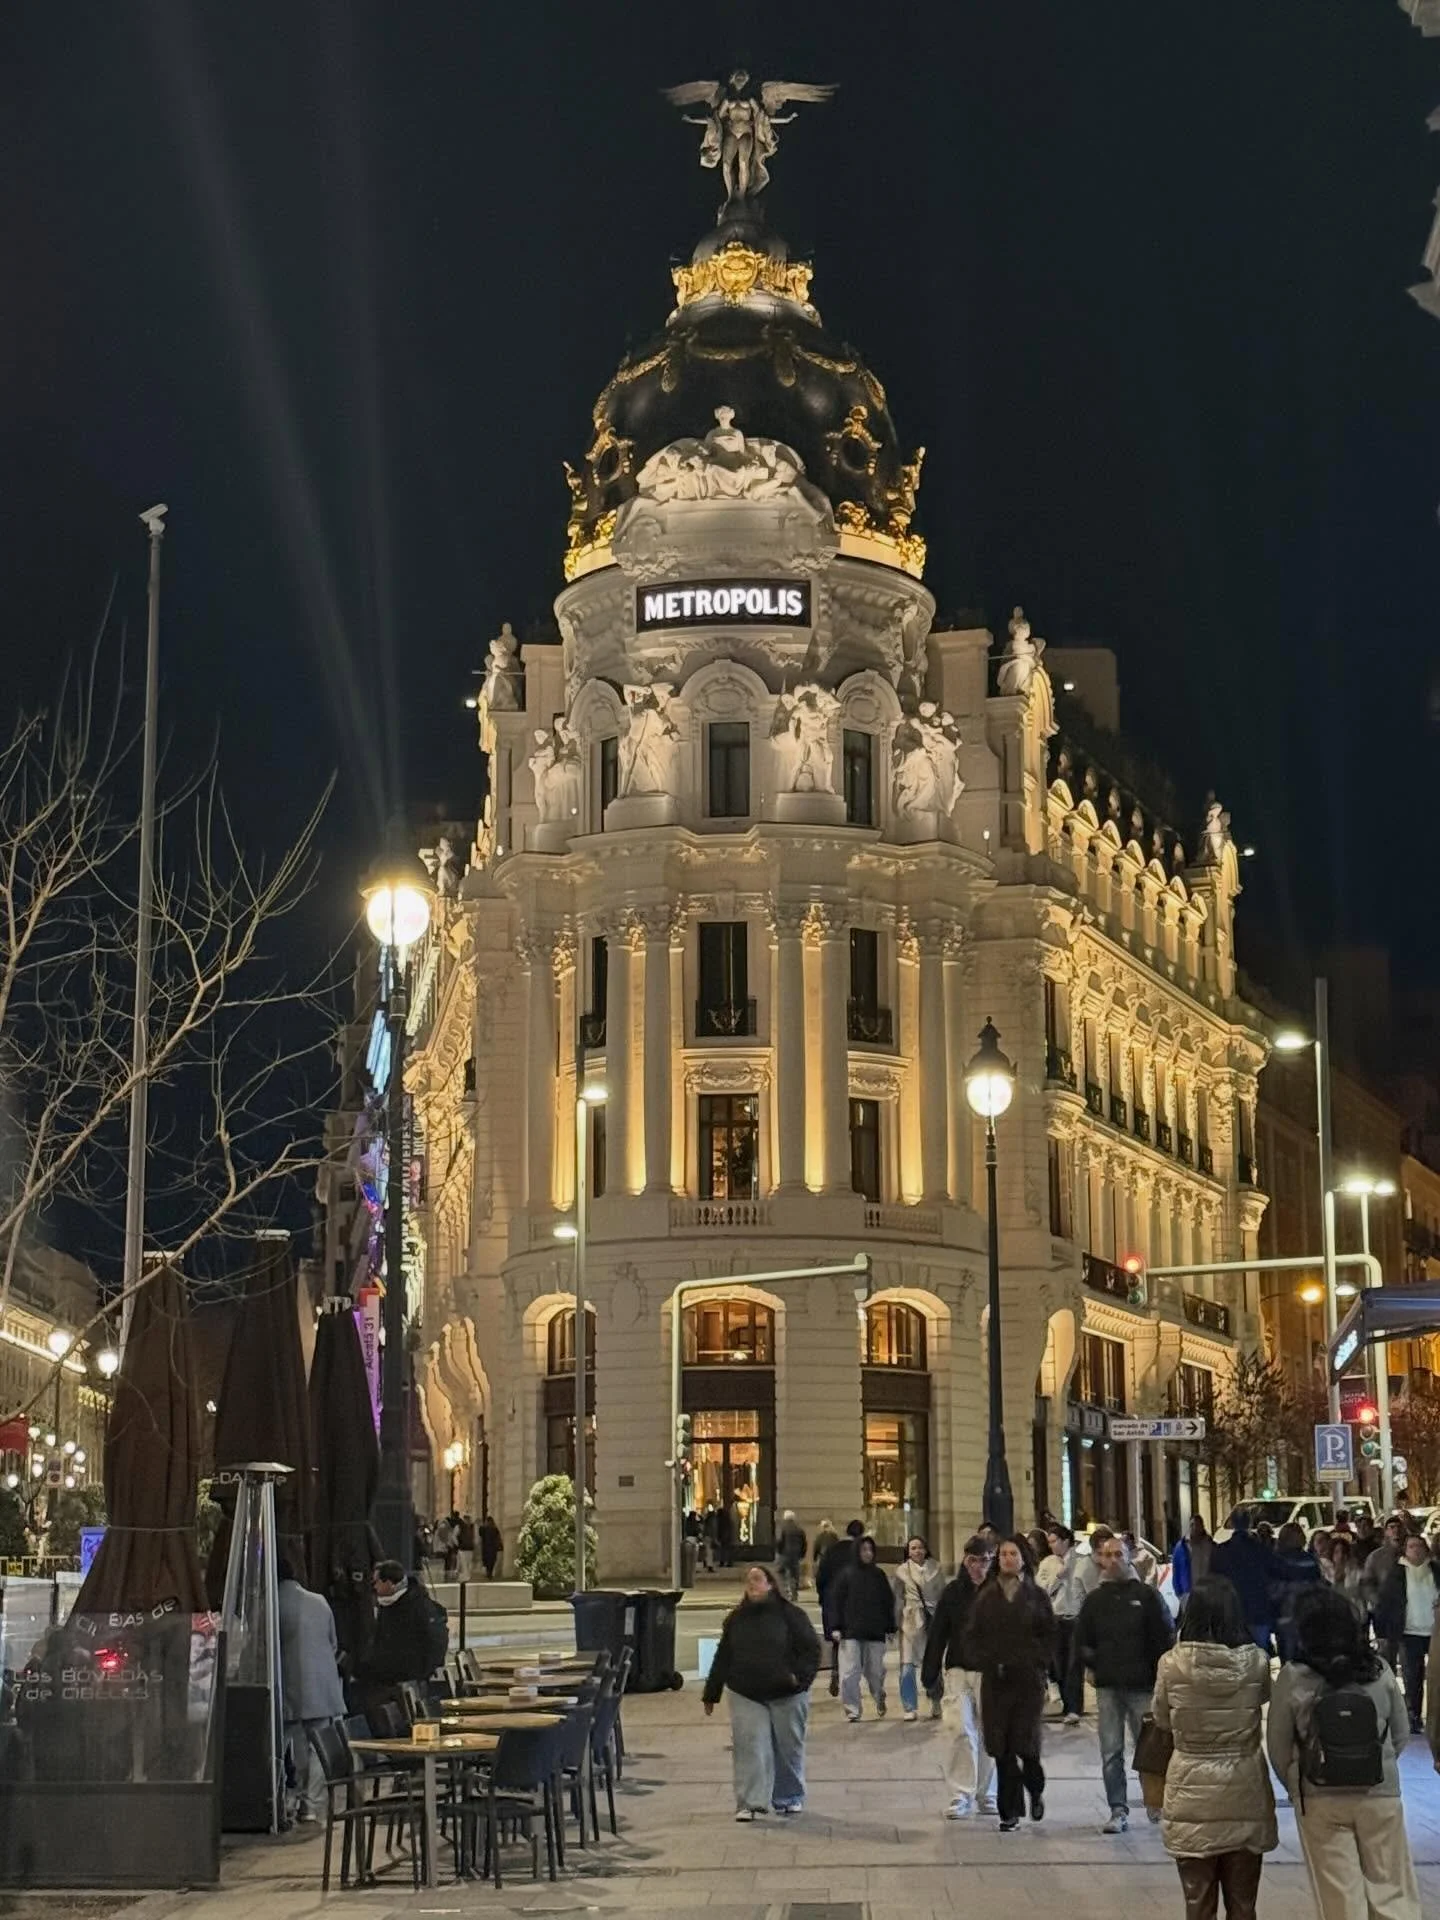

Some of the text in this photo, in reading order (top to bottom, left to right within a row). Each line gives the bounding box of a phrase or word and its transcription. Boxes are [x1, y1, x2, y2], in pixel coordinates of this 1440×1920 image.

[644, 588, 803, 622] METROPOLIS
[364, 1316, 374, 1331] 31
[1325, 1434, 1345, 1463] P
[152, 1600, 176, 1619] de
[13, 1671, 52, 1682] Las
[26, 1688, 52, 1699] de
